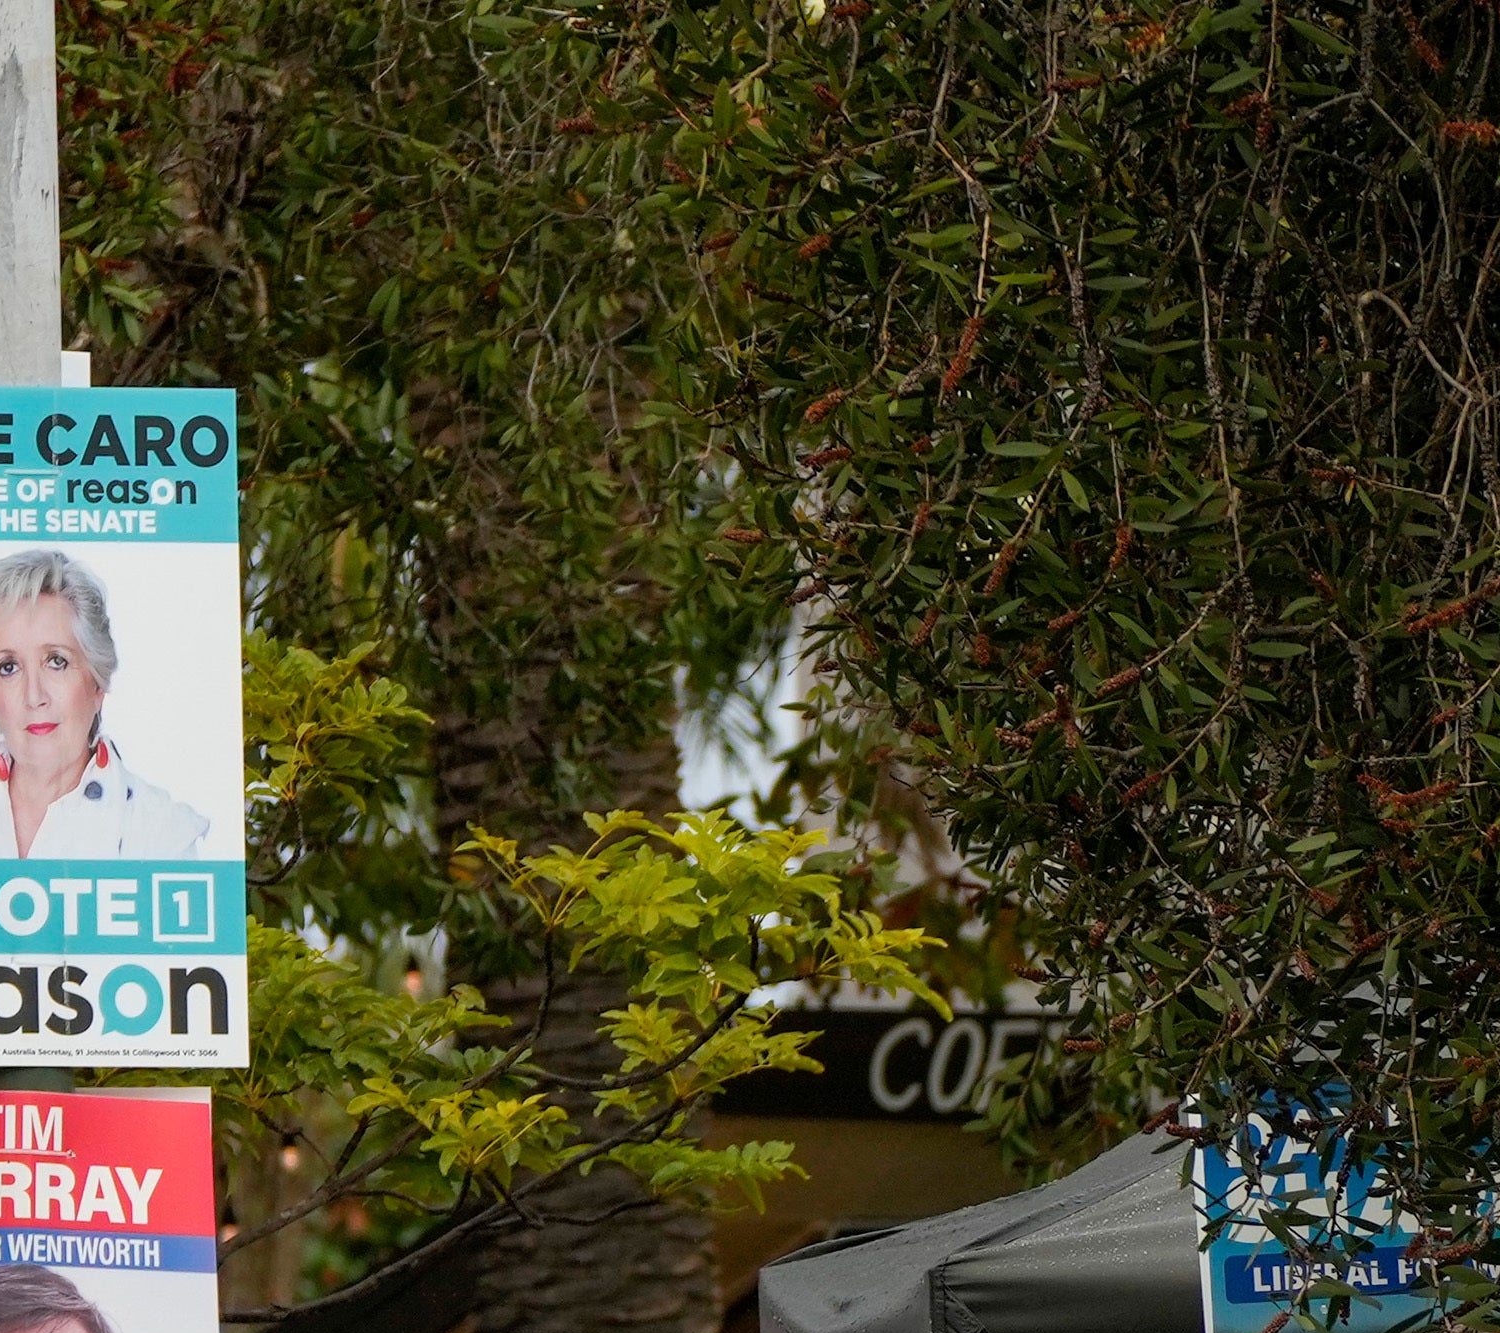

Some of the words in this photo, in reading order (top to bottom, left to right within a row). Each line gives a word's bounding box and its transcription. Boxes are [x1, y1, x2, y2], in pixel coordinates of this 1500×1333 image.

[36, 414, 229, 467] CARO
[16, 479, 55, 502] OF
[67, 478, 196, 505] reason
[45, 509, 157, 534] SENATE
[172, 890, 191, 928] 1
[133, 1050, 180, 1058] Collingwood
[8, 1235, 160, 1267] WENTWORTH
